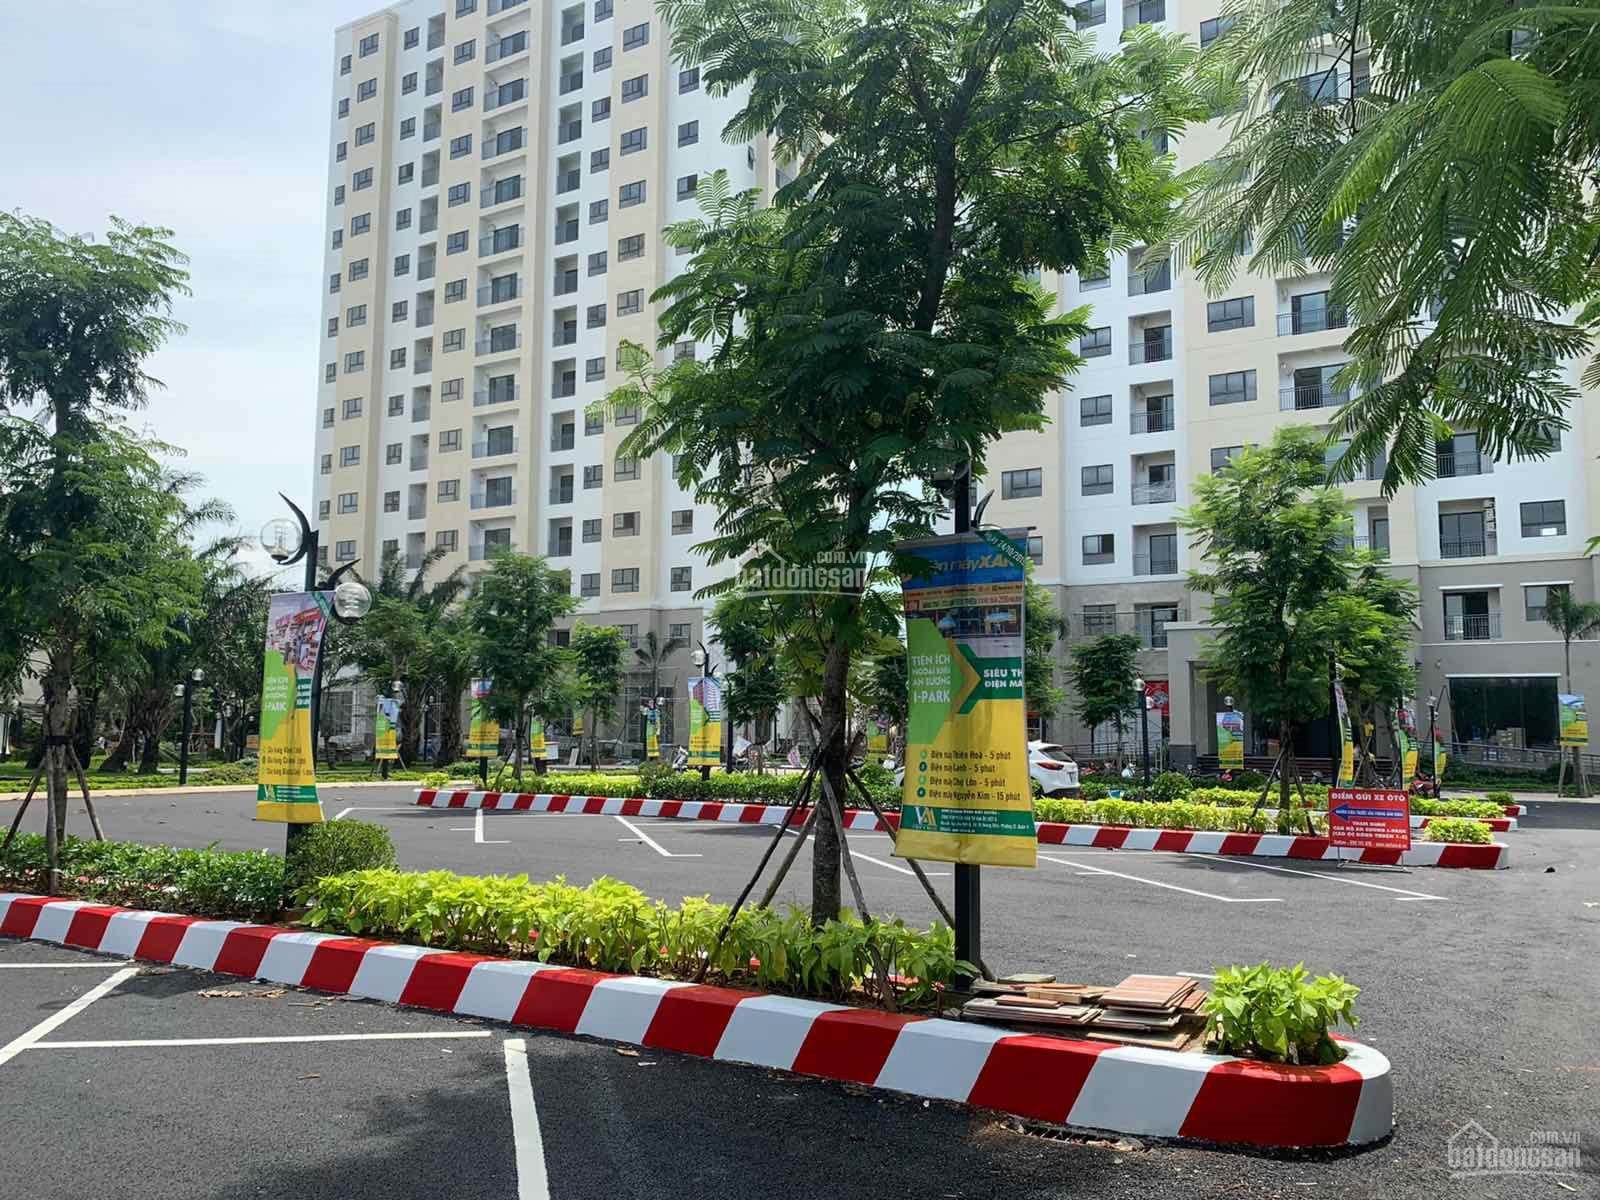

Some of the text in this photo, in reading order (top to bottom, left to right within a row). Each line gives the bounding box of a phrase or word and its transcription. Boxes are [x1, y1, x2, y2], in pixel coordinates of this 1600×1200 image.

[983, 667, 1023, 678] SIÊU TH
[1009, 678, 1024, 689] MÁ
[913, 689, 951, 703] I-PARK
